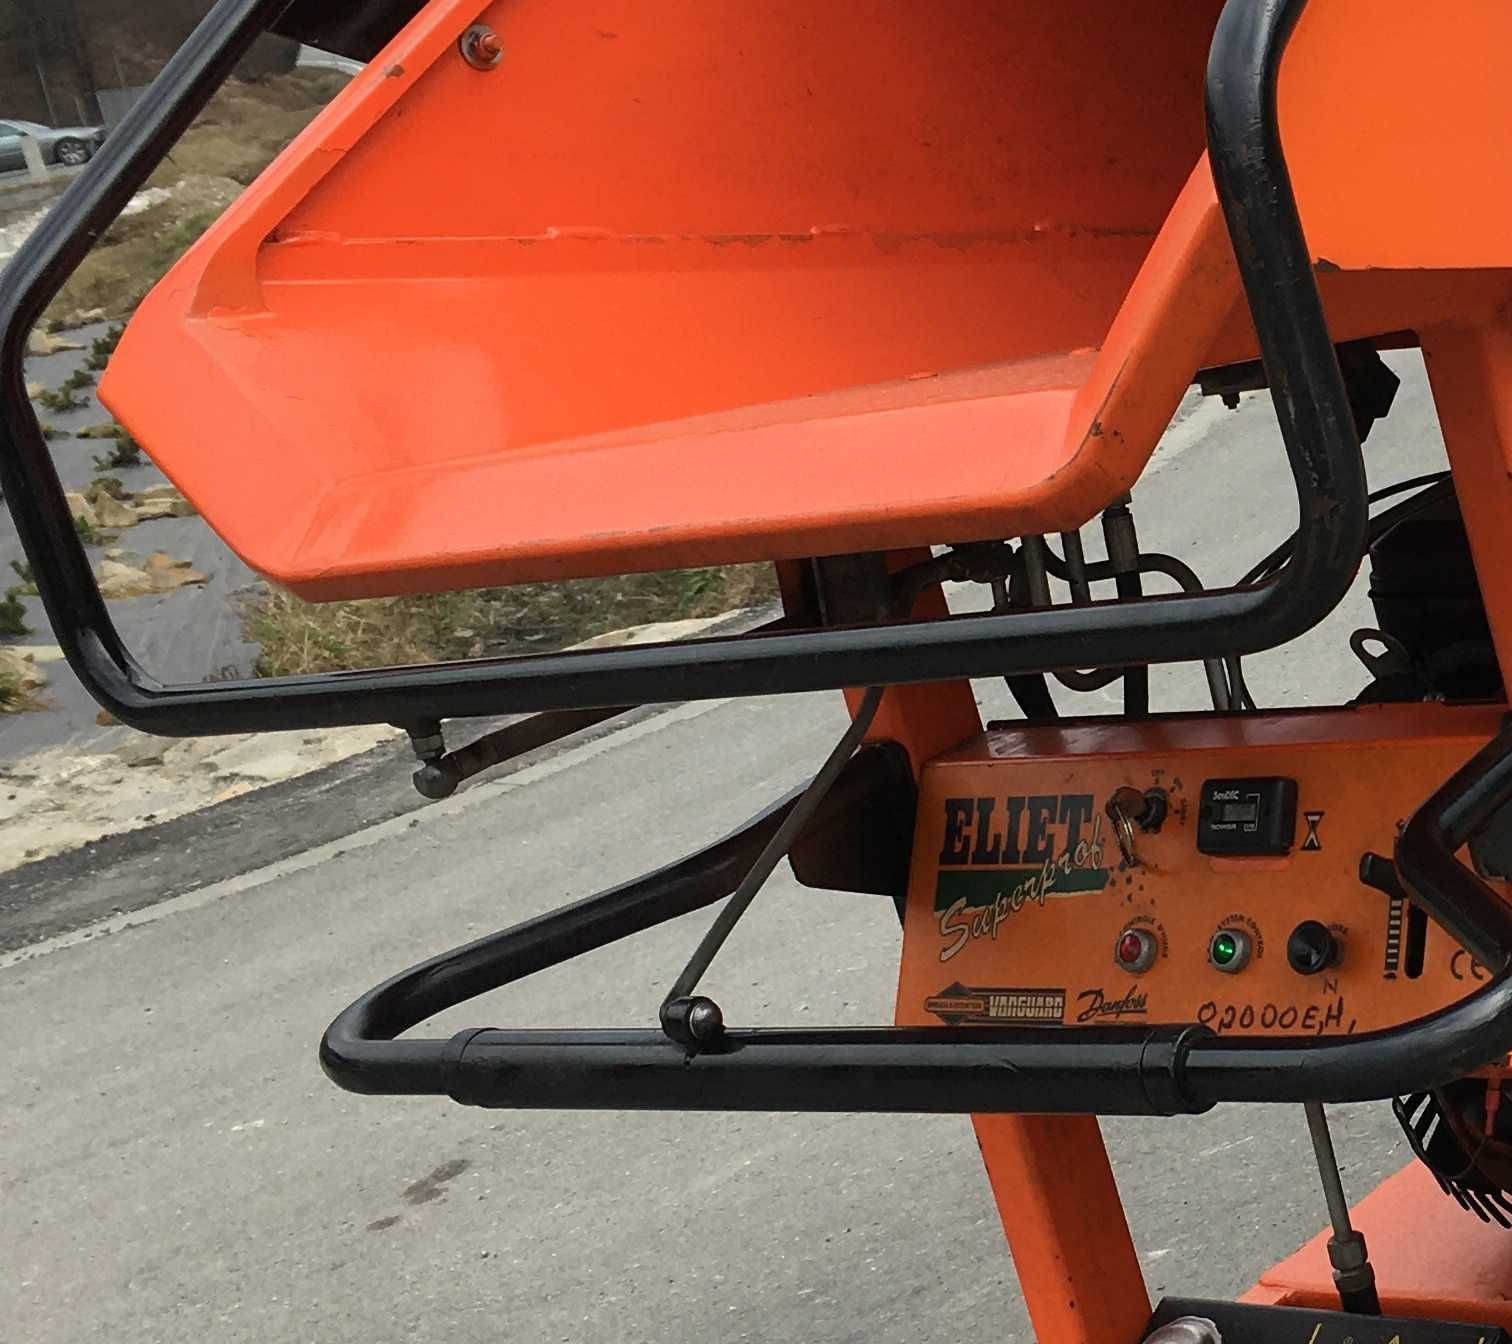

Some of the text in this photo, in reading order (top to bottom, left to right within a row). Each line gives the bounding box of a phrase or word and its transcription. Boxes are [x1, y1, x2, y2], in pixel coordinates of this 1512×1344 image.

[938, 794, 1094, 865] ELIET
[940, 816, 1103, 962] Superprof
[988, 995, 1064, 1018] VANGUARD
[1077, 984, 1148, 1023] Danfoss
